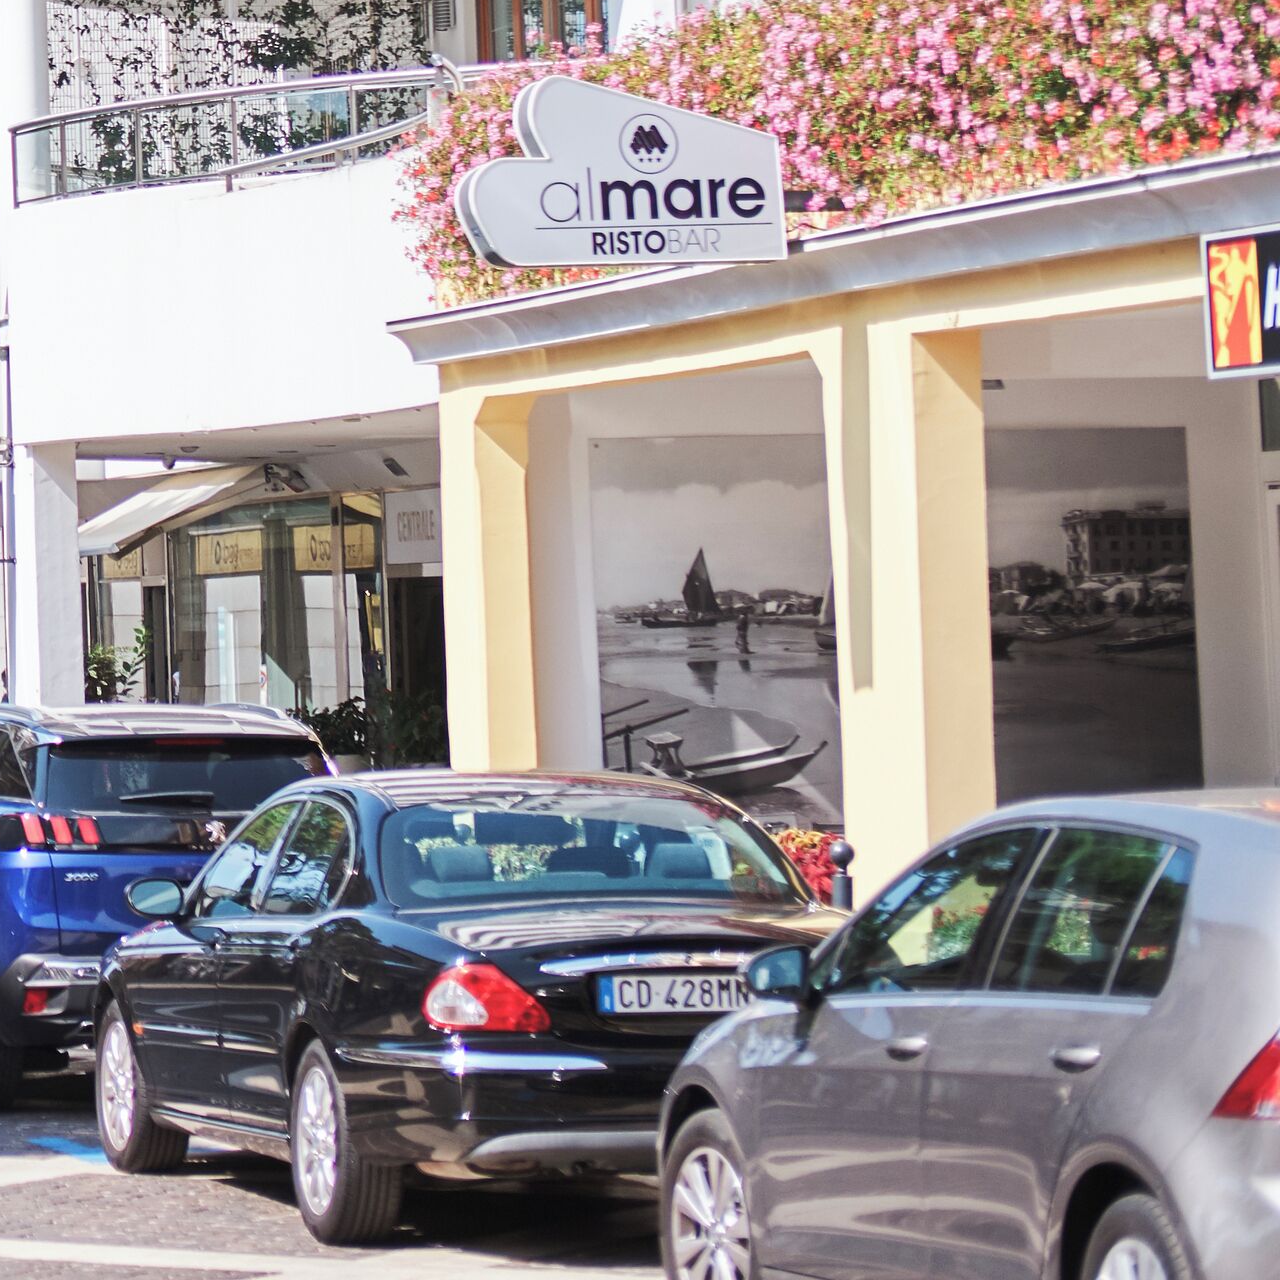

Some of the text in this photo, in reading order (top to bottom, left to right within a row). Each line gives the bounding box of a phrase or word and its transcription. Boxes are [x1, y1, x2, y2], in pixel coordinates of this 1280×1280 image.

[540, 166, 766, 223] almare
[591, 228, 721, 256] RISTOBAR
[397, 509, 434, 543] CENTRALE
[618, 980, 652, 1008] CD
